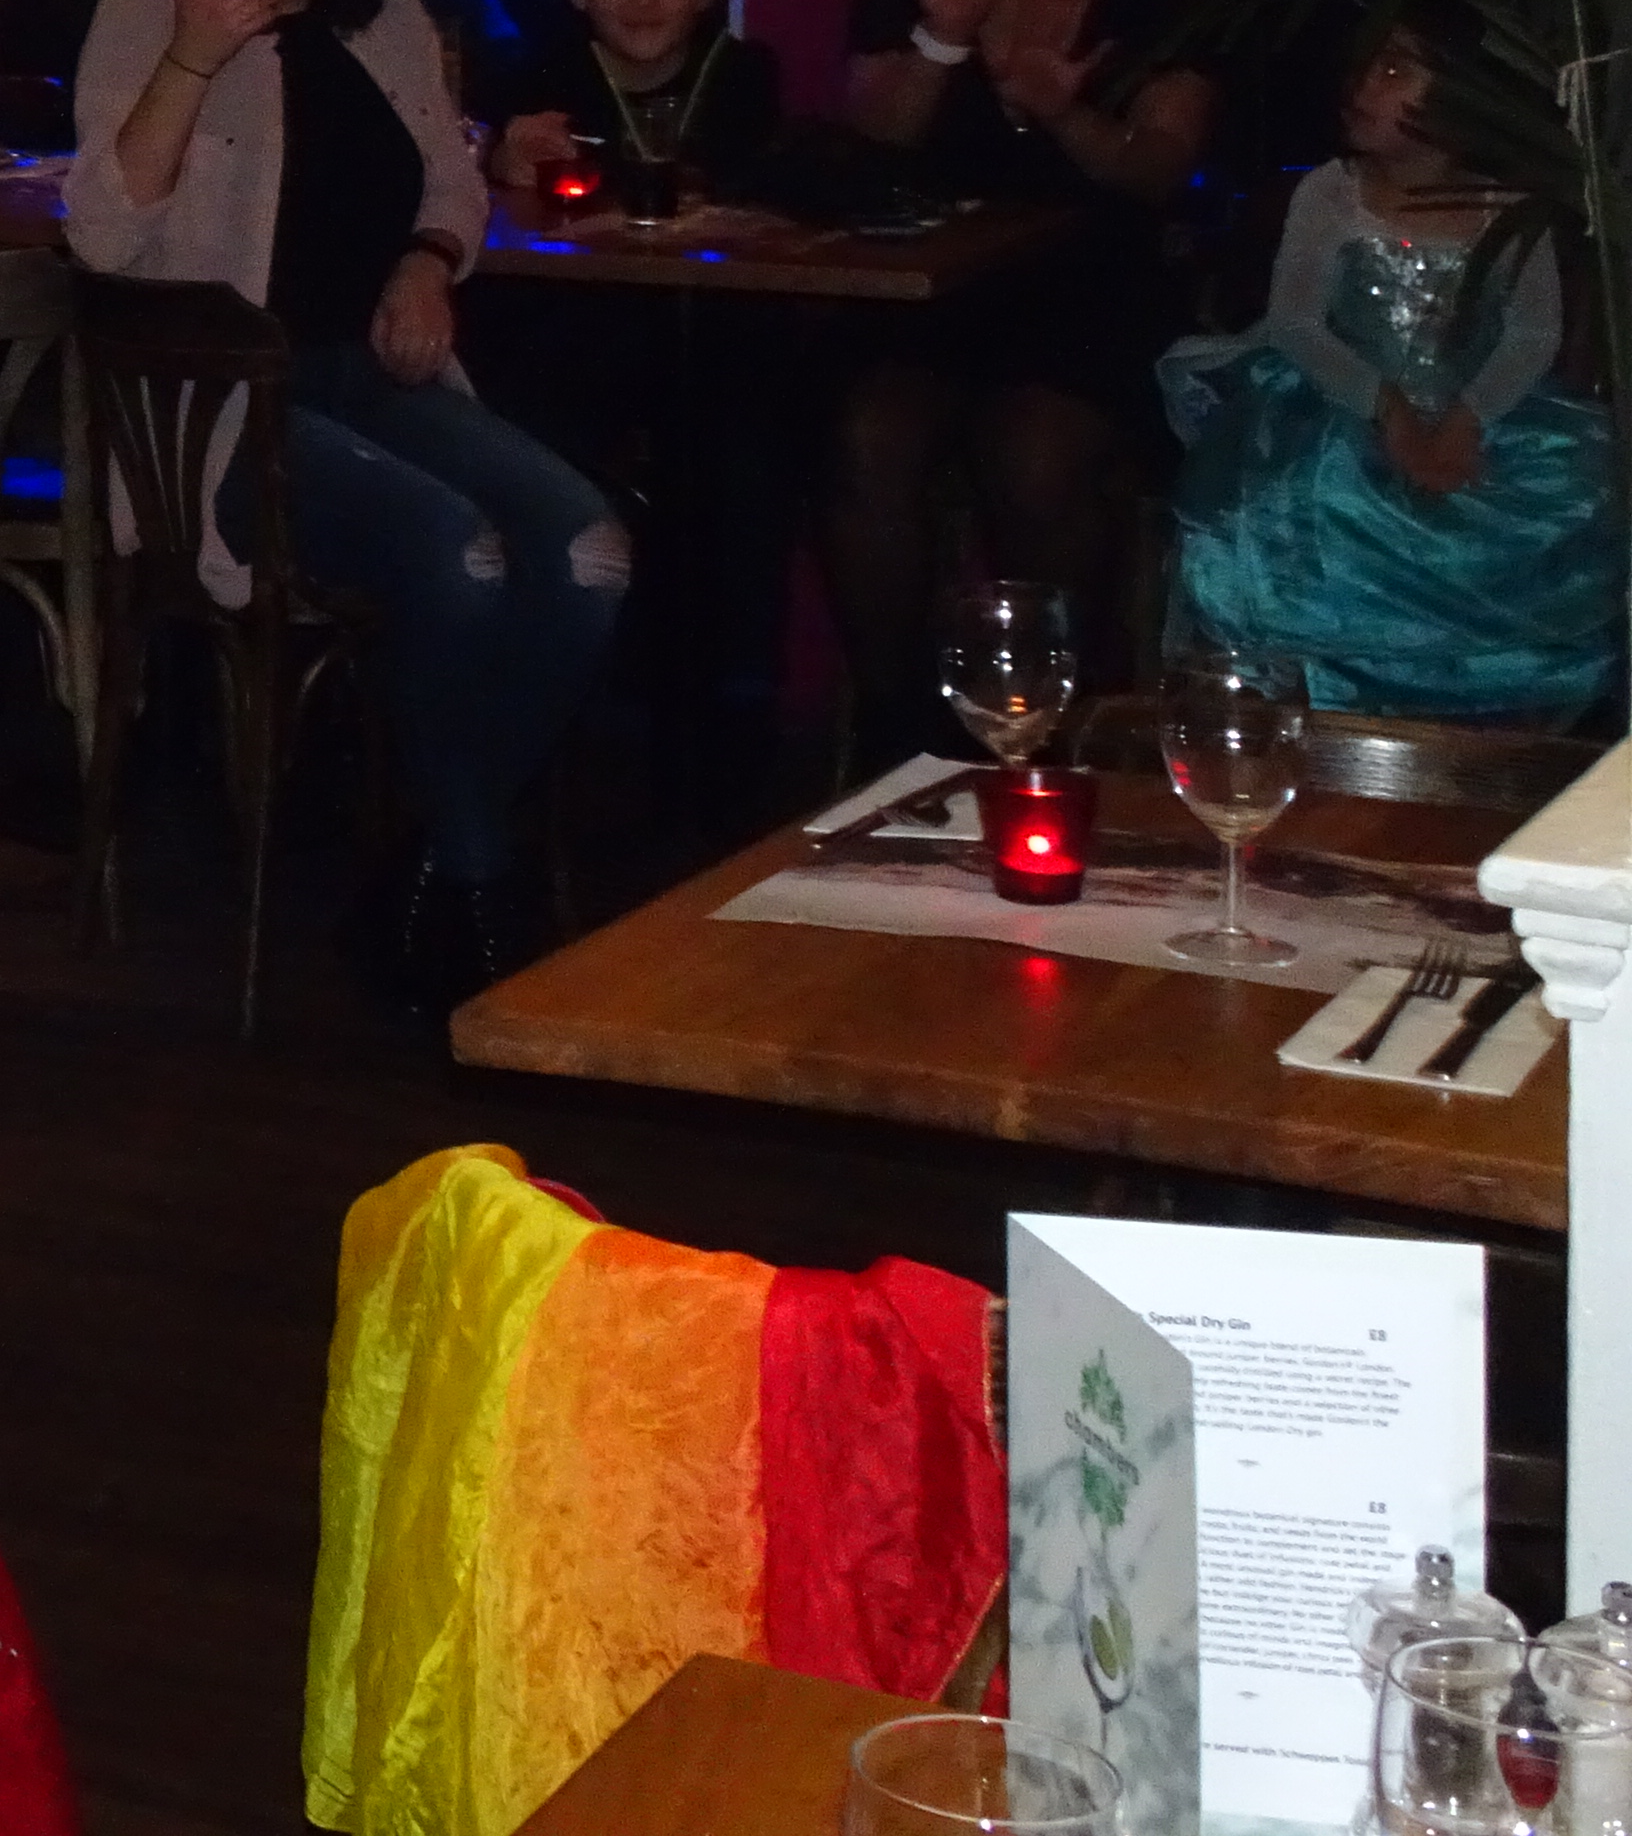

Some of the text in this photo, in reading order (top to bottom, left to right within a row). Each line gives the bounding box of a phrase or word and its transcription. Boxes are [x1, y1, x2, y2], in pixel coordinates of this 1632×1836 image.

[1148, 1312, 1251, 1330] Special Dry Gin
